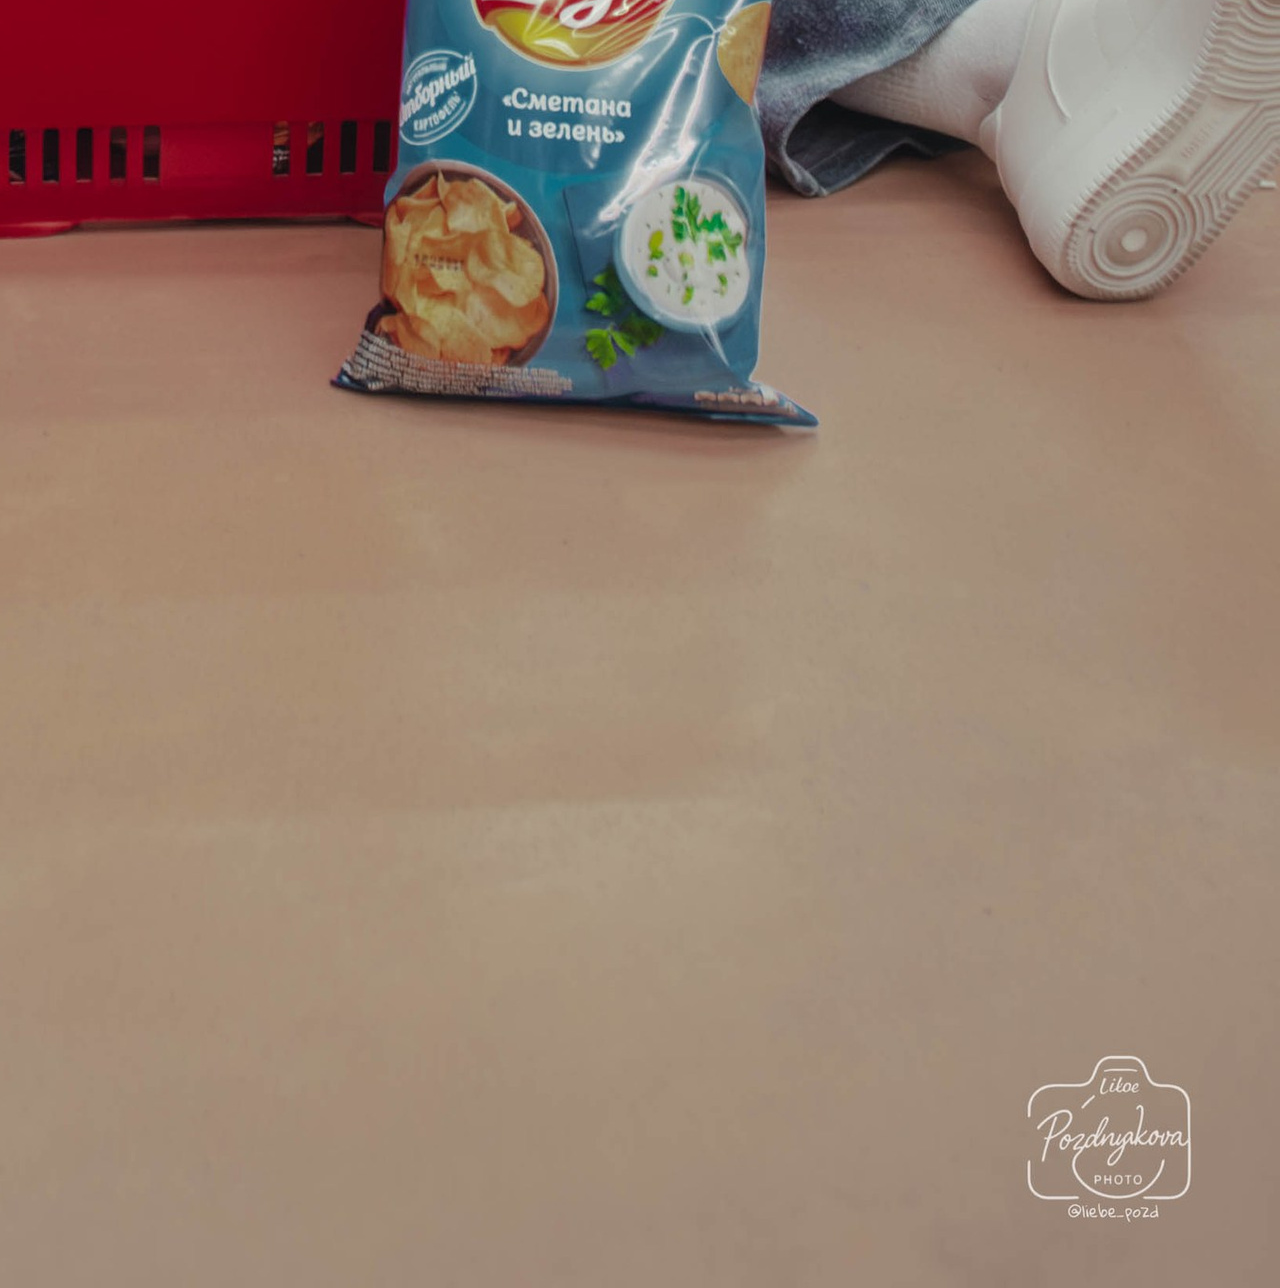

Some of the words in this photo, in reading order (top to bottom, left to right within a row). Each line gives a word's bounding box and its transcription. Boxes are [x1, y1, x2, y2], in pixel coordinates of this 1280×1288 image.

[502, 87, 631, 118] «Сметана
[507, 118, 522, 137] и
[528, 120, 625, 145] зелень»
